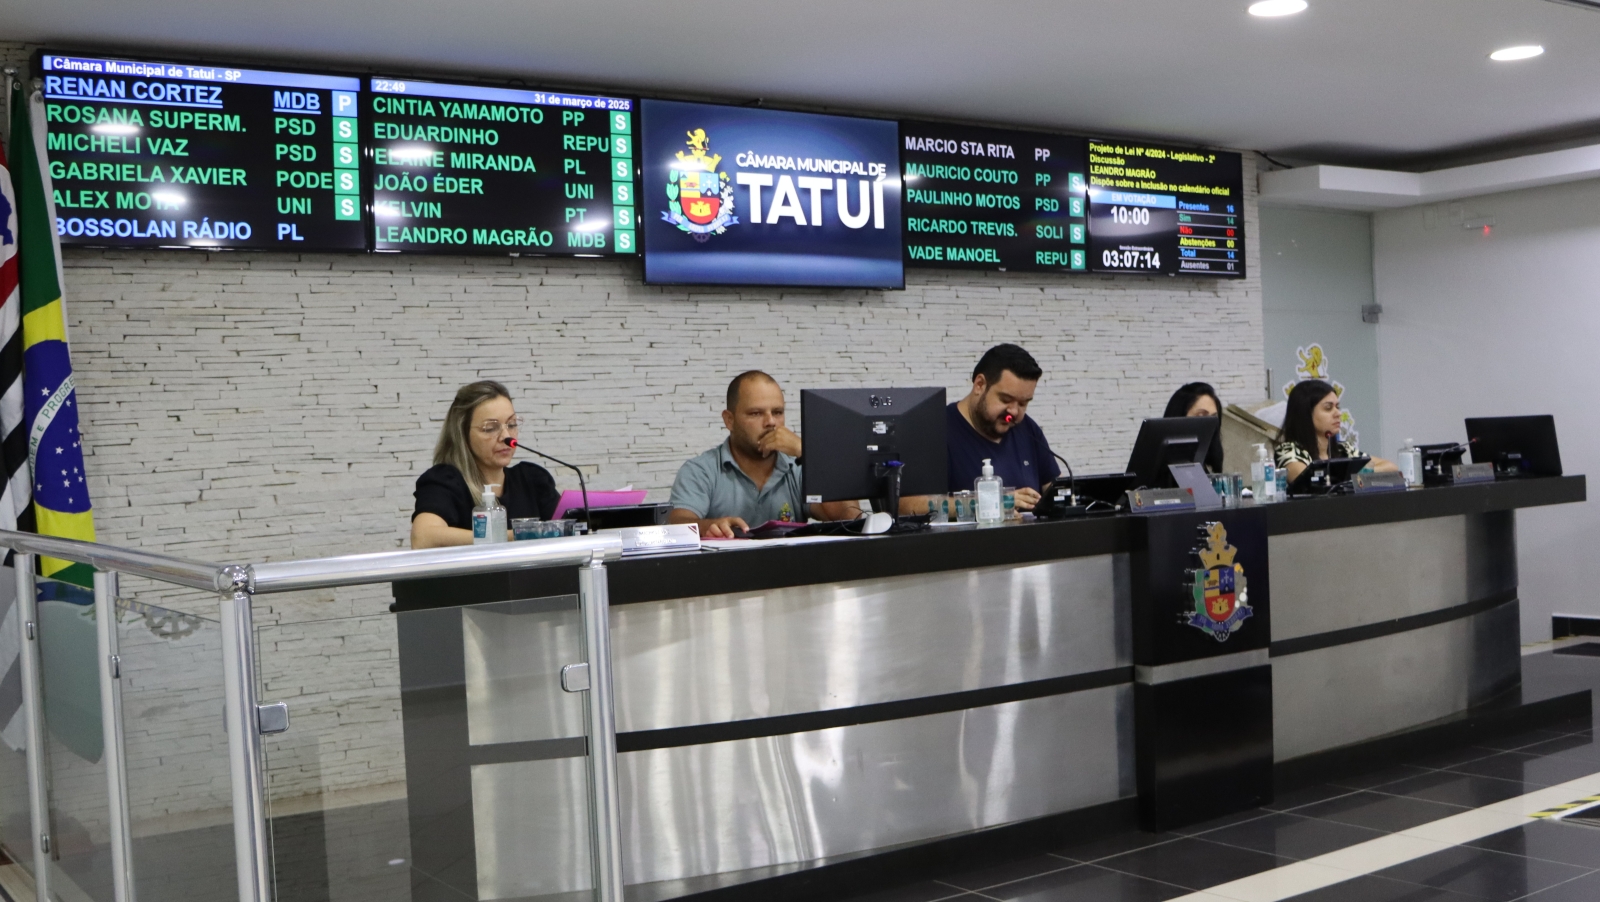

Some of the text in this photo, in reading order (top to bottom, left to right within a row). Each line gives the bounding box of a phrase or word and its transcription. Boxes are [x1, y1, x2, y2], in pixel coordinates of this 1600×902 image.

[53, 58, 103, 73] Câmara
[105, 61, 165, 78] Municipal
[168, 64, 183, 77] de
[184, 65, 215, 80] Tatuí
[224, 70, 242, 81] SP
[46, 76, 351, 111] RENAN CORTEZ MDB P
[375, 81, 630, 110] 22:49 31 de março de 2025
[47, 104, 351, 138] ROSANA SUPERM. PSD S
[373, 97, 626, 130] CINTIA YAMAMOTO PP S
[48, 132, 352, 164] MICHELI VAZ PSD S
[374, 123, 627, 153] EDUARDINHO REPU S
[905, 136, 1050, 161] MARCIO STA RITA PP
[374, 148, 628, 177] ELAINE MIRANDA PL S
[736, 150, 886, 177] CÂMARA MUNICIPAL DE
[1089, 143, 1114, 154] Projeto
[1115, 146, 1124, 154] de
[1124, 146, 1135, 156] Lei
[1145, 149, 1166, 158] 4/2024
[1170, 150, 1204, 162] Legislativo
[1090, 154, 1125, 166] Discussão
[50, 161, 353, 190] GABRIELA XAVIER PODE S
[906, 163, 1080, 189] MAURICIO COUTO PP S
[1090, 165, 1156, 179] LEANDRO MAGRÃO
[374, 171, 628, 201] JOÃO ÉDER UNI S
[1090, 176, 1114, 187] Dispõe
[1116, 179, 1134, 188] sobre
[1168, 184, 1178, 192] no
[1178, 184, 1210, 194] calendário
[1211, 186, 1230, 196] oficial
[52, 190, 109, 209] ALEX
[277, 197, 312, 214] UNI
[341, 199, 354, 216] S
[736, 172, 886, 229] TATUÍ
[907, 189, 1080, 213] PAULINHO MOTOS PSD S
[1112, 193, 1156, 205] EM VOTAÇÃO
[1178, 201, 1234, 213] Presentes 16
[565, 208, 586, 223] PT
[618, 209, 629, 225] S
[1111, 206, 1149, 225] 10:00
[1179, 214, 1234, 225] Sim 14
[57, 217, 304, 240] BOSSOLAN RÁDIO PL
[375, 226, 630, 248] LEANDRO MAGRÃO MDB S
[908, 218, 1081, 240] RICARDO TREVIS. SOLI S
[1180, 225, 1234, 237] Não 00
[1180, 237, 1234, 248] Abstenções 00
[1180, 248, 1196, 258] Total
[908, 245, 1082, 266] VADE MANOEL REPU S
[1103, 250, 1160, 269] 03:07:14
[1180, 260, 1234, 270] Ausentes 01
[36, 424, 44, 432] E
